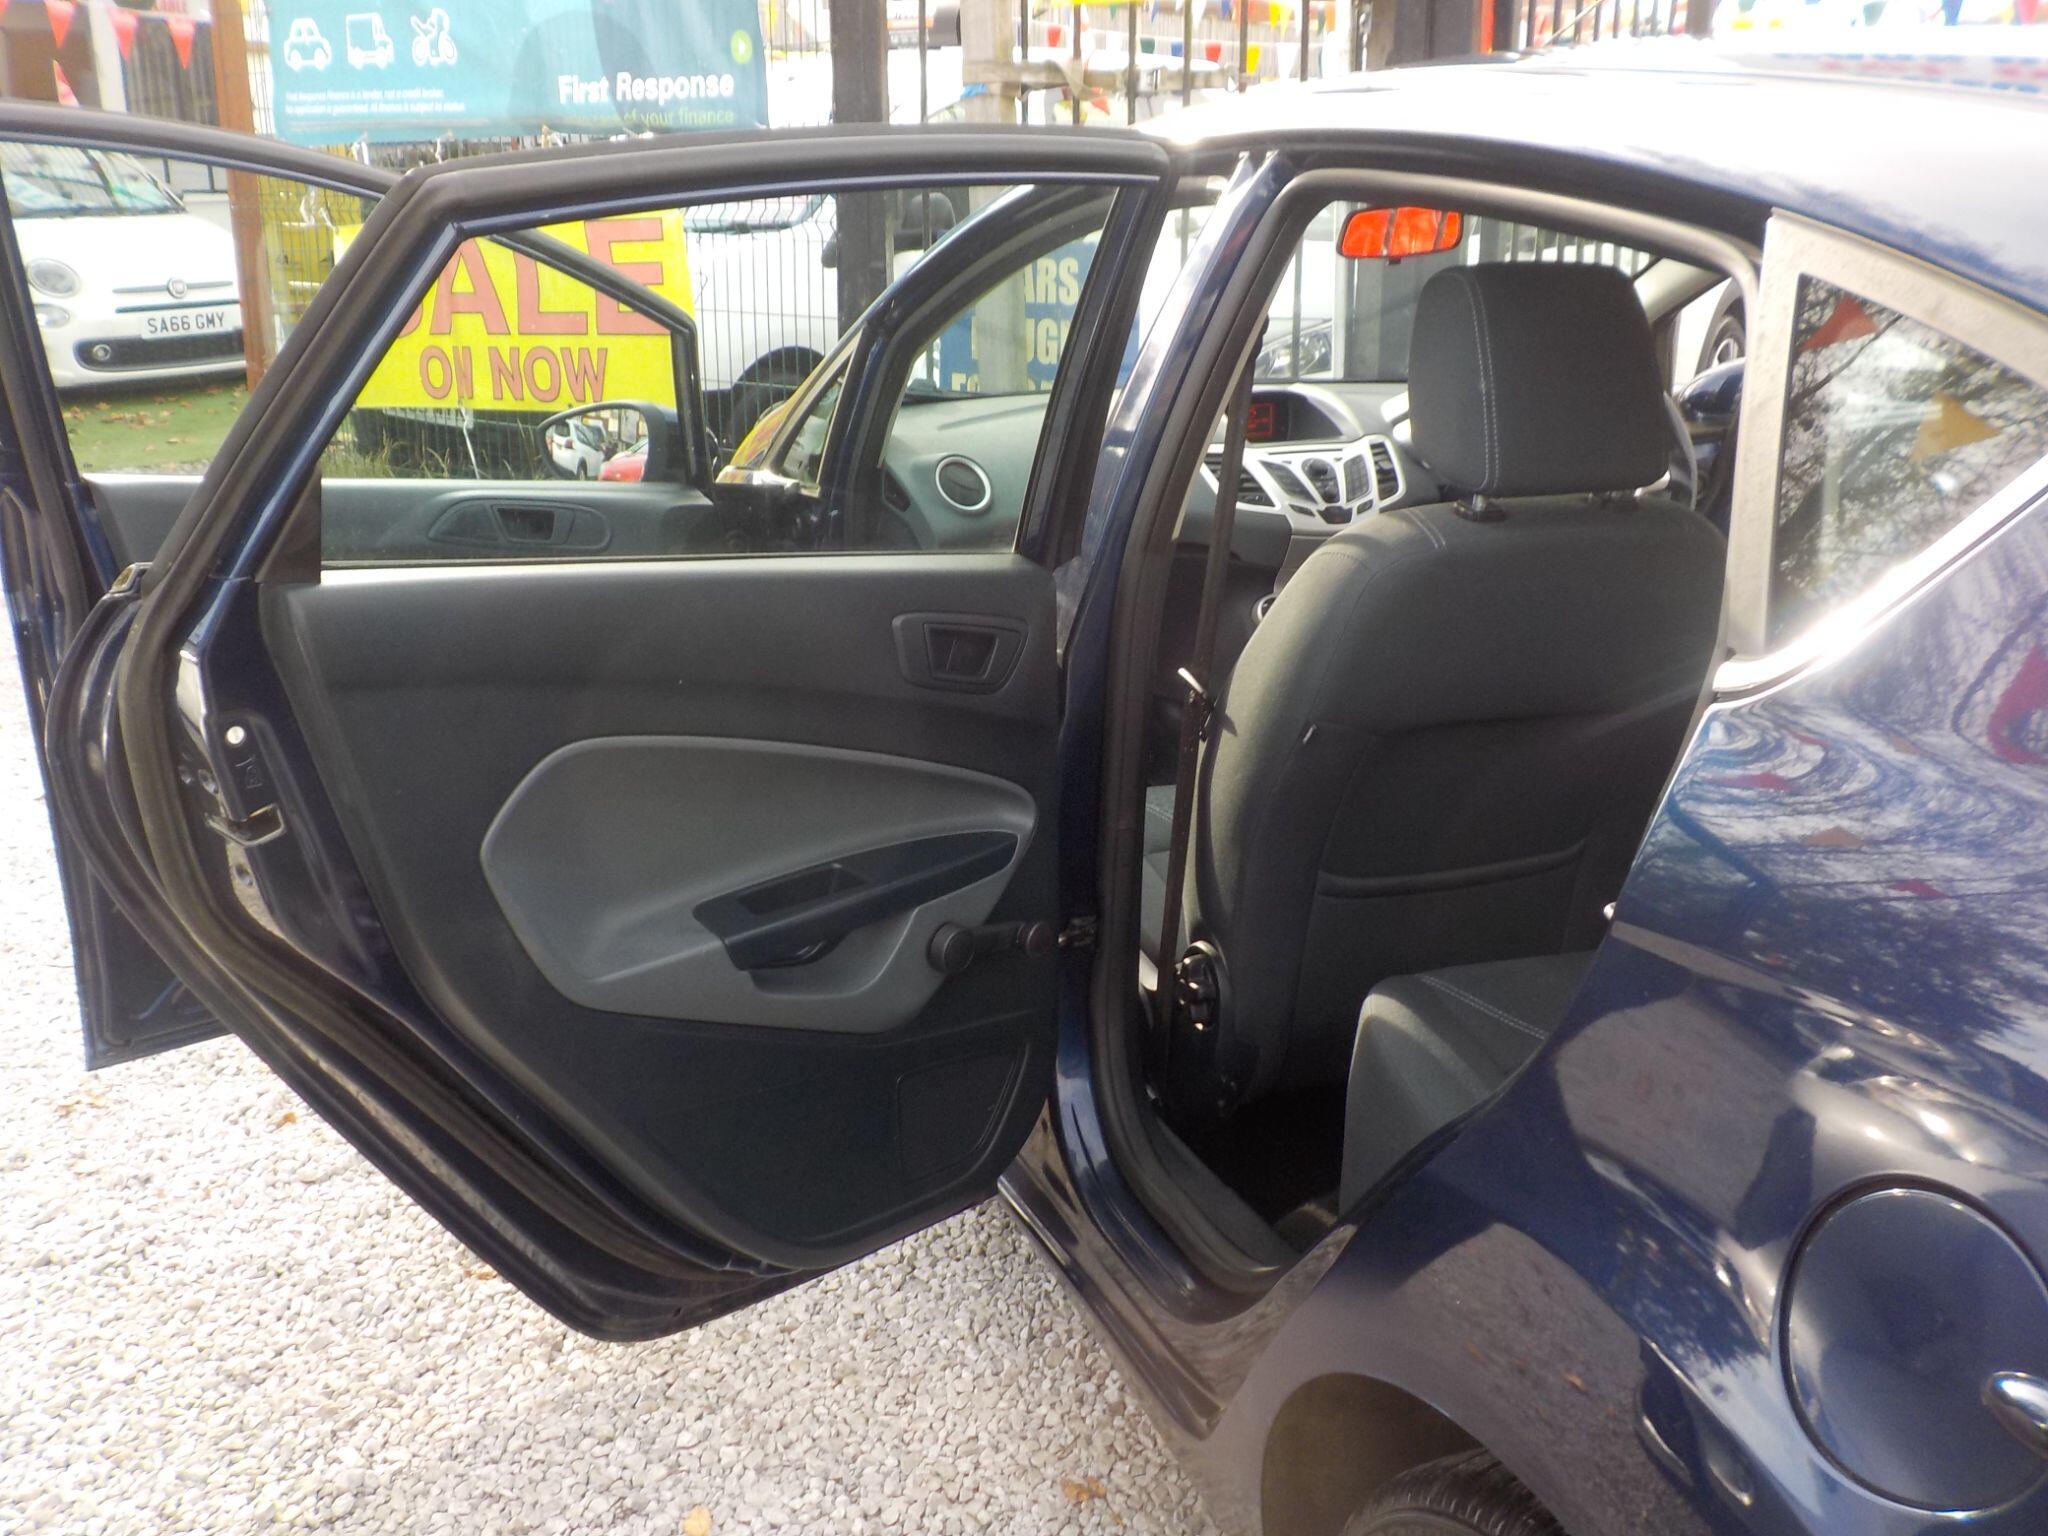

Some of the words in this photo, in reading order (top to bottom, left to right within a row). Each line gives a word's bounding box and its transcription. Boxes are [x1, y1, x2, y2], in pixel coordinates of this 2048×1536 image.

[558, 74, 609, 104] First
[616, 71, 735, 106] Response
[640, 112, 674, 128] your
[678, 107, 734, 124] finance
[399, 217, 672, 339] ALE
[147, 315, 191, 334] SA66
[195, 312, 224, 330] GMY
[488, 346, 608, 402] NOW
